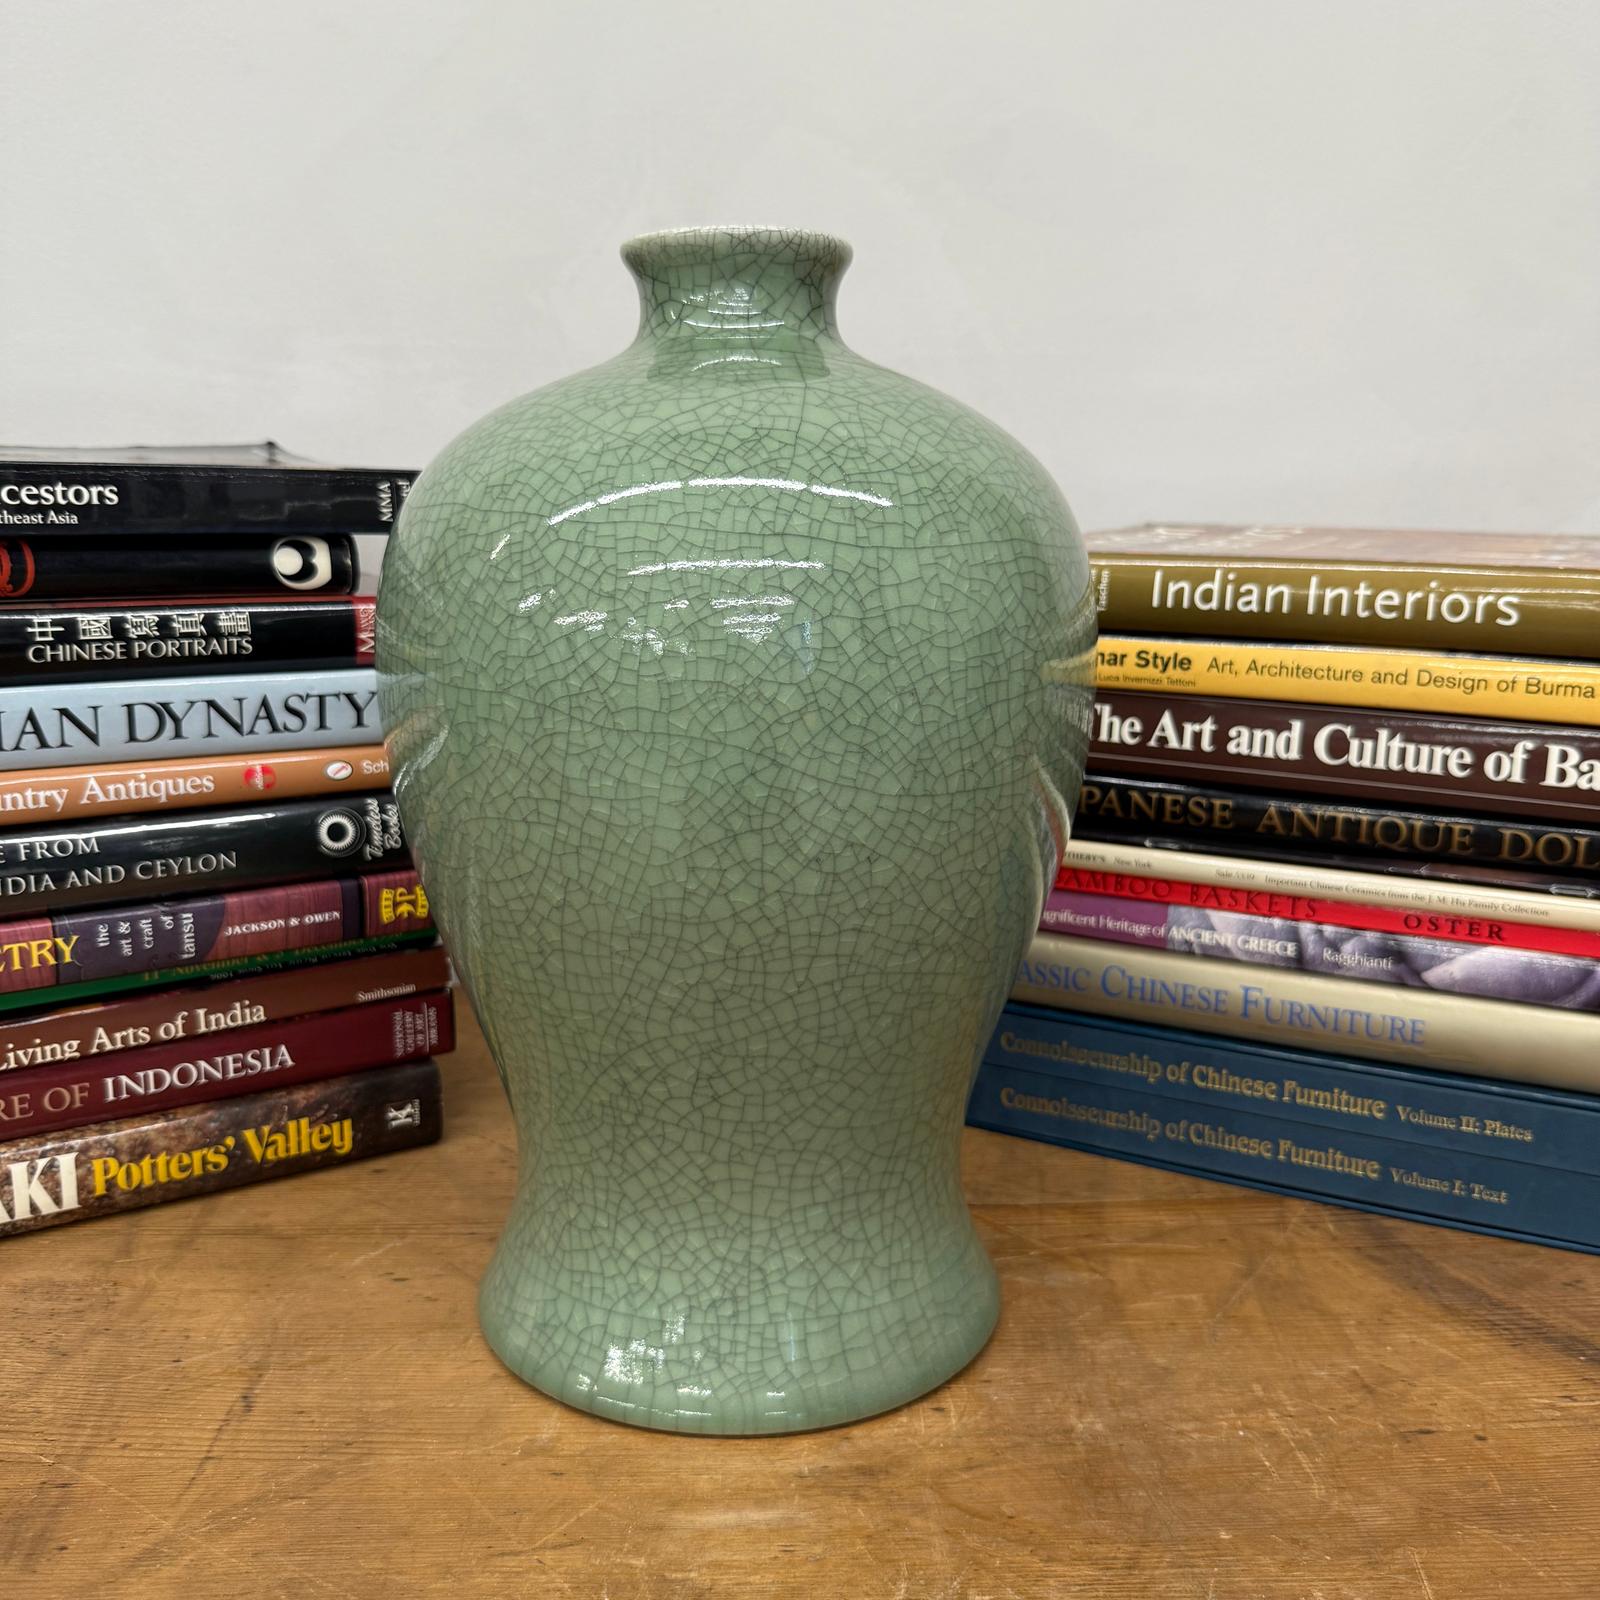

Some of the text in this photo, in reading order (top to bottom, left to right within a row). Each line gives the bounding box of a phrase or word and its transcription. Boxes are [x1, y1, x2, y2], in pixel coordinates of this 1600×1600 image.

[47, 510, 80, 524] Asia
[1152, 567, 1521, 626] Indian Interiors
[27, 636, 253, 663] CHINESE PORTRAITS
[1134, 649, 1192, 674] Style
[1206, 656, 1239, 677] Art,
[1245, 658, 1363, 683] Architecture
[1371, 668, 1408, 686] and
[1416, 669, 1489, 695] Design
[1496, 674, 1519, 693] of
[1524, 676, 1596, 699] Burma
[121, 690, 377, 745] DYNASTY
[1146, 708, 1218, 752] Art
[1226, 718, 1305, 761] and
[1313, 722, 1475, 779] Culture
[1483, 740, 1536, 784] of
[1540, 743, 1600, 792] Ba
[80, 773, 215, 805] Antiques
[19, 838, 101, 861] FROM
[364, 798, 384, 861] Timeless
[381, 803, 401, 850] Books
[1079, 785, 1600, 869] PANESE ANTIQUE DOL
[0, 850, 238, 896] DIA AND CEYLON
[1264, 874, 1307, 889] Important
[1309, 879, 1344, 892] Chinese
[1345, 883, 1386, 896] Ceramics
[1387, 890, 1408, 899] from
[1411, 892, 1426, 902] the
[1467, 899, 1499, 912] Family
[1501, 903, 1550, 917] Collection
[141, 917, 154, 949] craft
[224, 910, 341, 937] JACKSON & OWEN
[1190, 881, 1316, 918] BASKETS
[1403, 914, 1504, 940] OSTER
[96, 923, 110, 947] the
[118, 921, 133, 957] art &
[180, 912, 196, 960] tansu
[1099, 915, 1151, 937] Heritage
[1152, 923, 1166, 938] of
[1168, 925, 1236, 949] ANCIENT
[1237, 934, 1298, 959] GREECE
[1322, 946, 1394, 970] Ragghianti
[357, 983, 417, 1003] Smithsonian
[1100, 964, 1231, 1014] CHINESE
[1240, 984, 1425, 1045] FURNITURE
[90, 1026, 151, 1054] Arts
[158, 1011, 189, 1041] of
[194, 1000, 267, 1035] India
[43, 1082, 90, 1113] OF
[103, 1044, 296, 1103] INDONESIA
[1000, 1031, 1162, 1083] Connoisseurship
[1166, 1061, 1190, 1083] of
[1192, 1064, 1278, 1101] Chinese
[1283, 1079, 1388, 1120] Furniture
[1396, 1104, 1456, 1130] Volume
[1483, 1119, 1535, 1144] Plates
[91, 1134, 236, 1199] Potters'
[243, 1116, 353, 1164] Valley
[1000, 1087, 1161, 1141] Connoisseurship
[1165, 1119, 1188, 1142] of
[1189, 1123, 1272, 1158] Chinese
[1277, 1138, 1383, 1182] Furniture
[1389, 1166, 1450, 1194] Volume
[1469, 1182, 1511, 1205] Text
